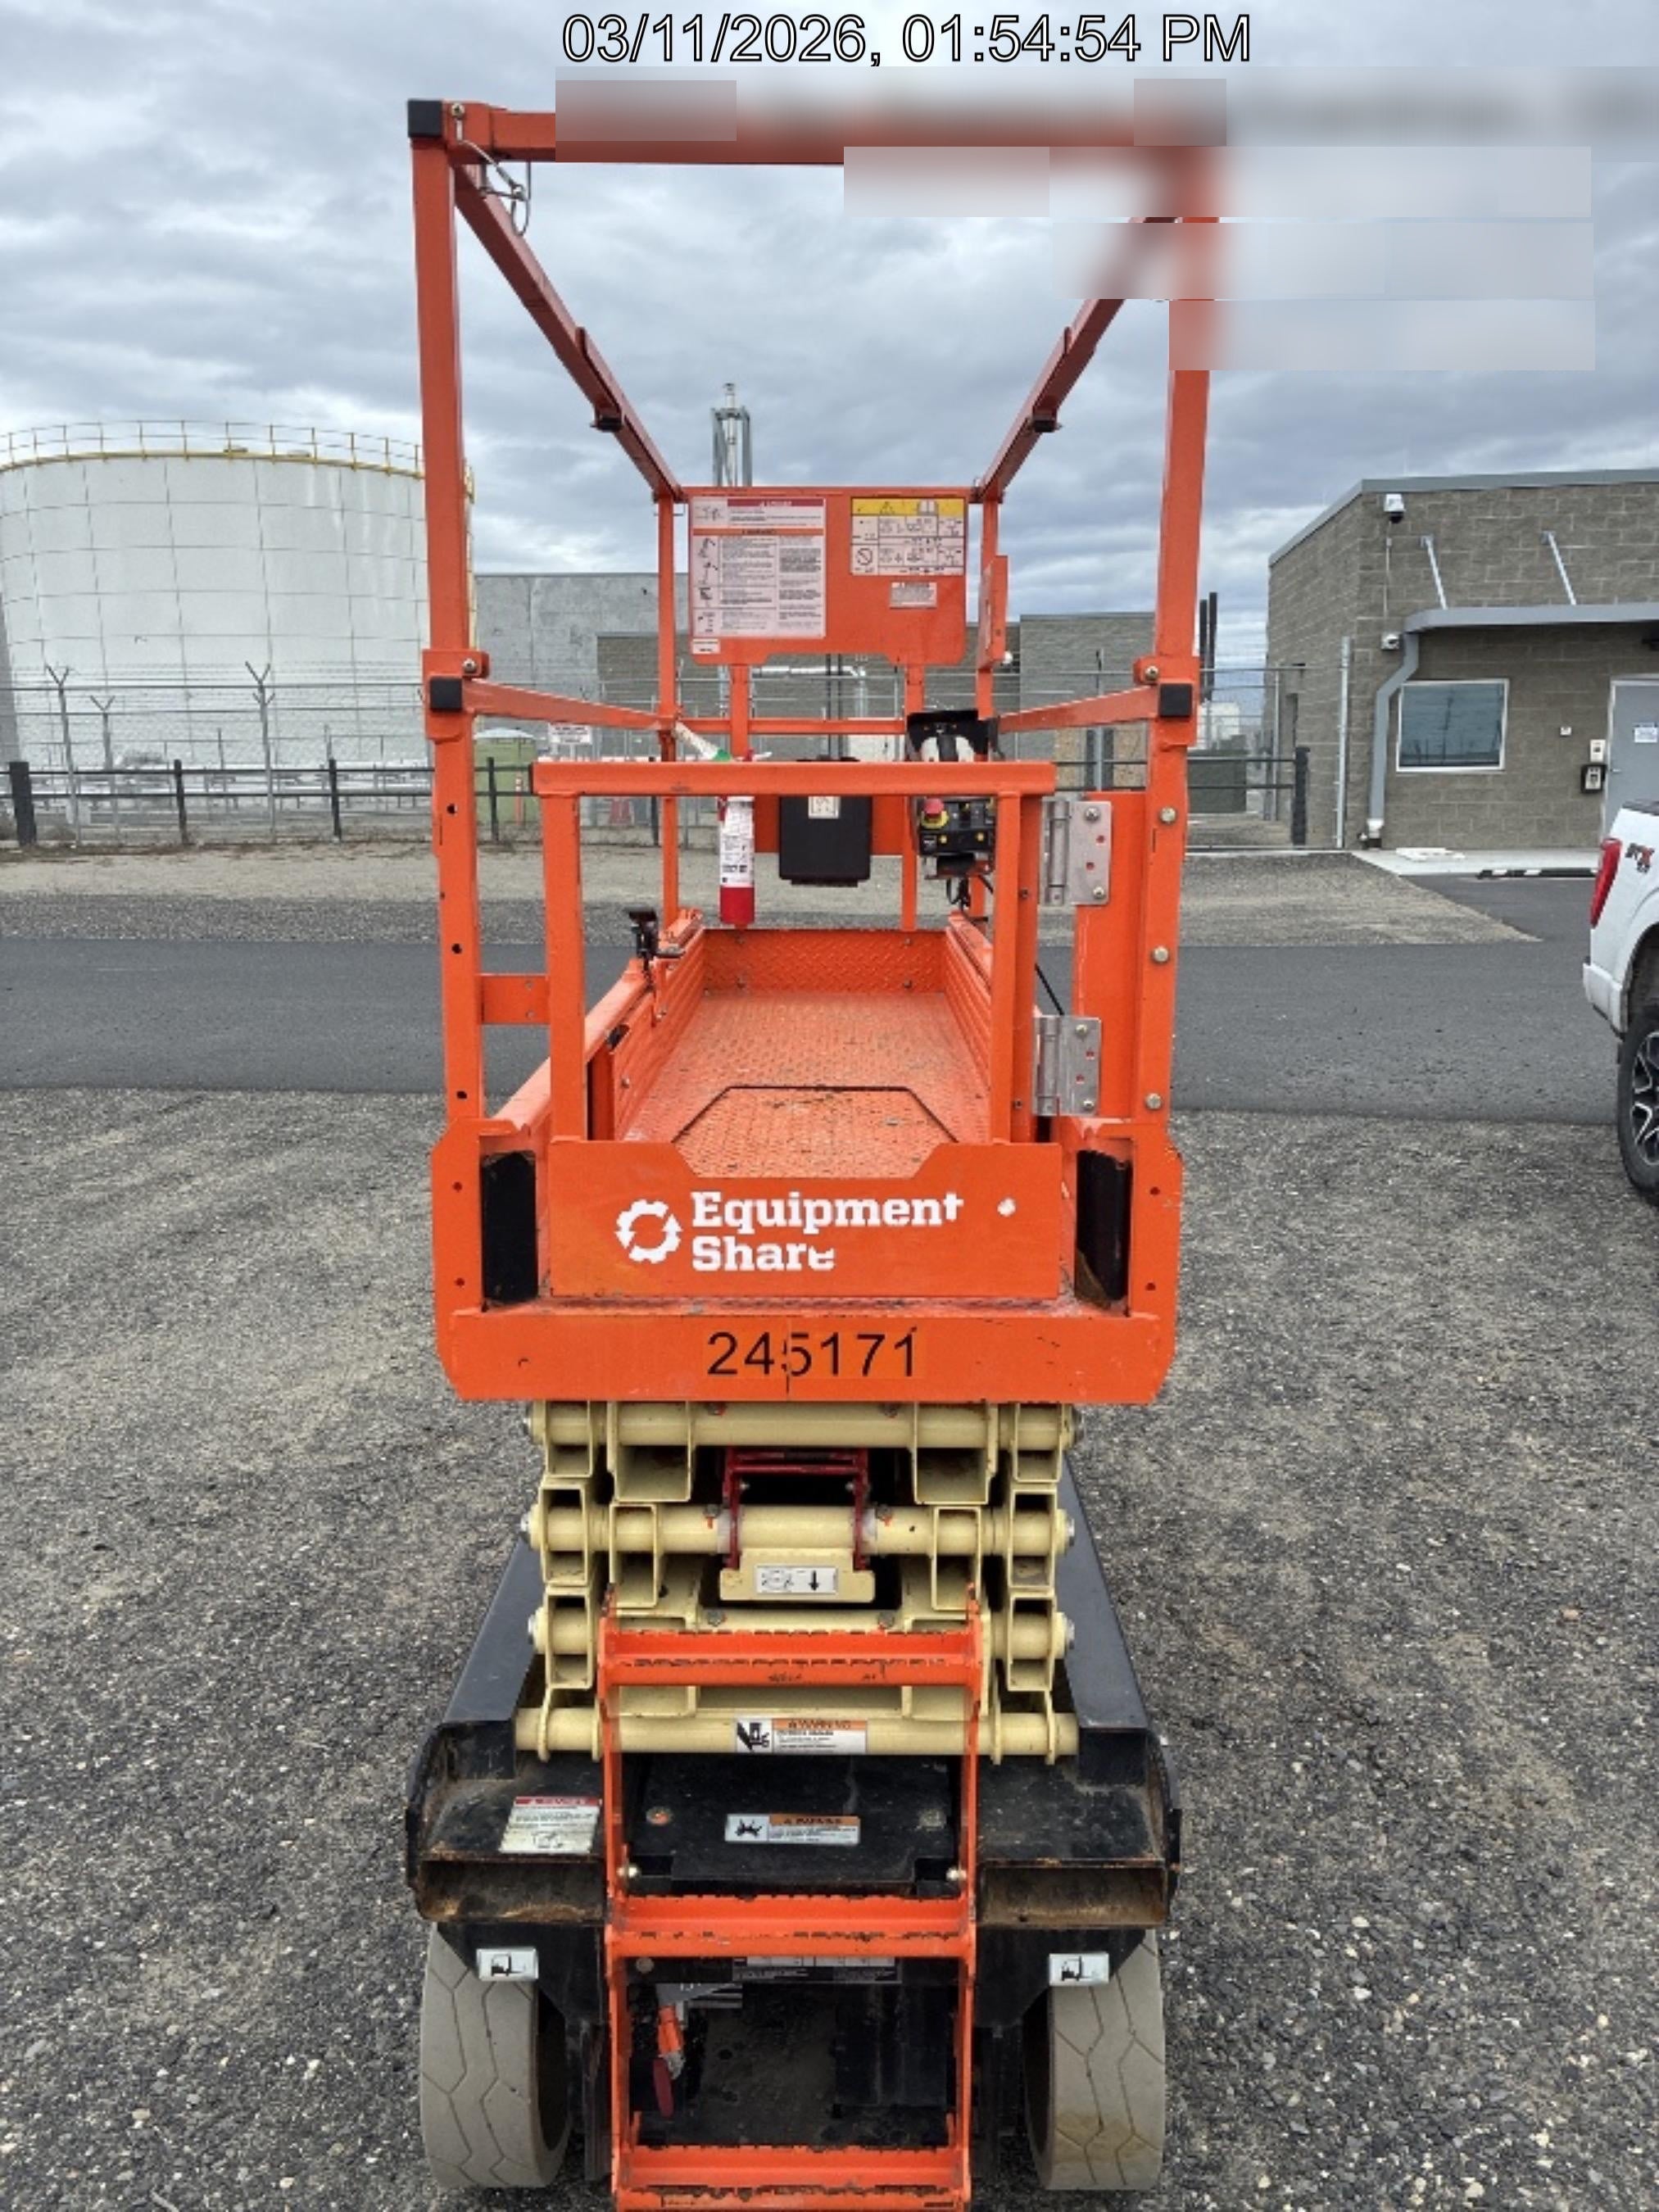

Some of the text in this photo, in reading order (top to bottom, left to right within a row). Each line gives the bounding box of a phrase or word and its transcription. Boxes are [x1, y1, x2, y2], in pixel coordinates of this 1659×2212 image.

[692, 1190, 964, 1235] Equipment
[692, 1237, 835, 1272] Share
[707, 1331, 918, 1377] 245171
